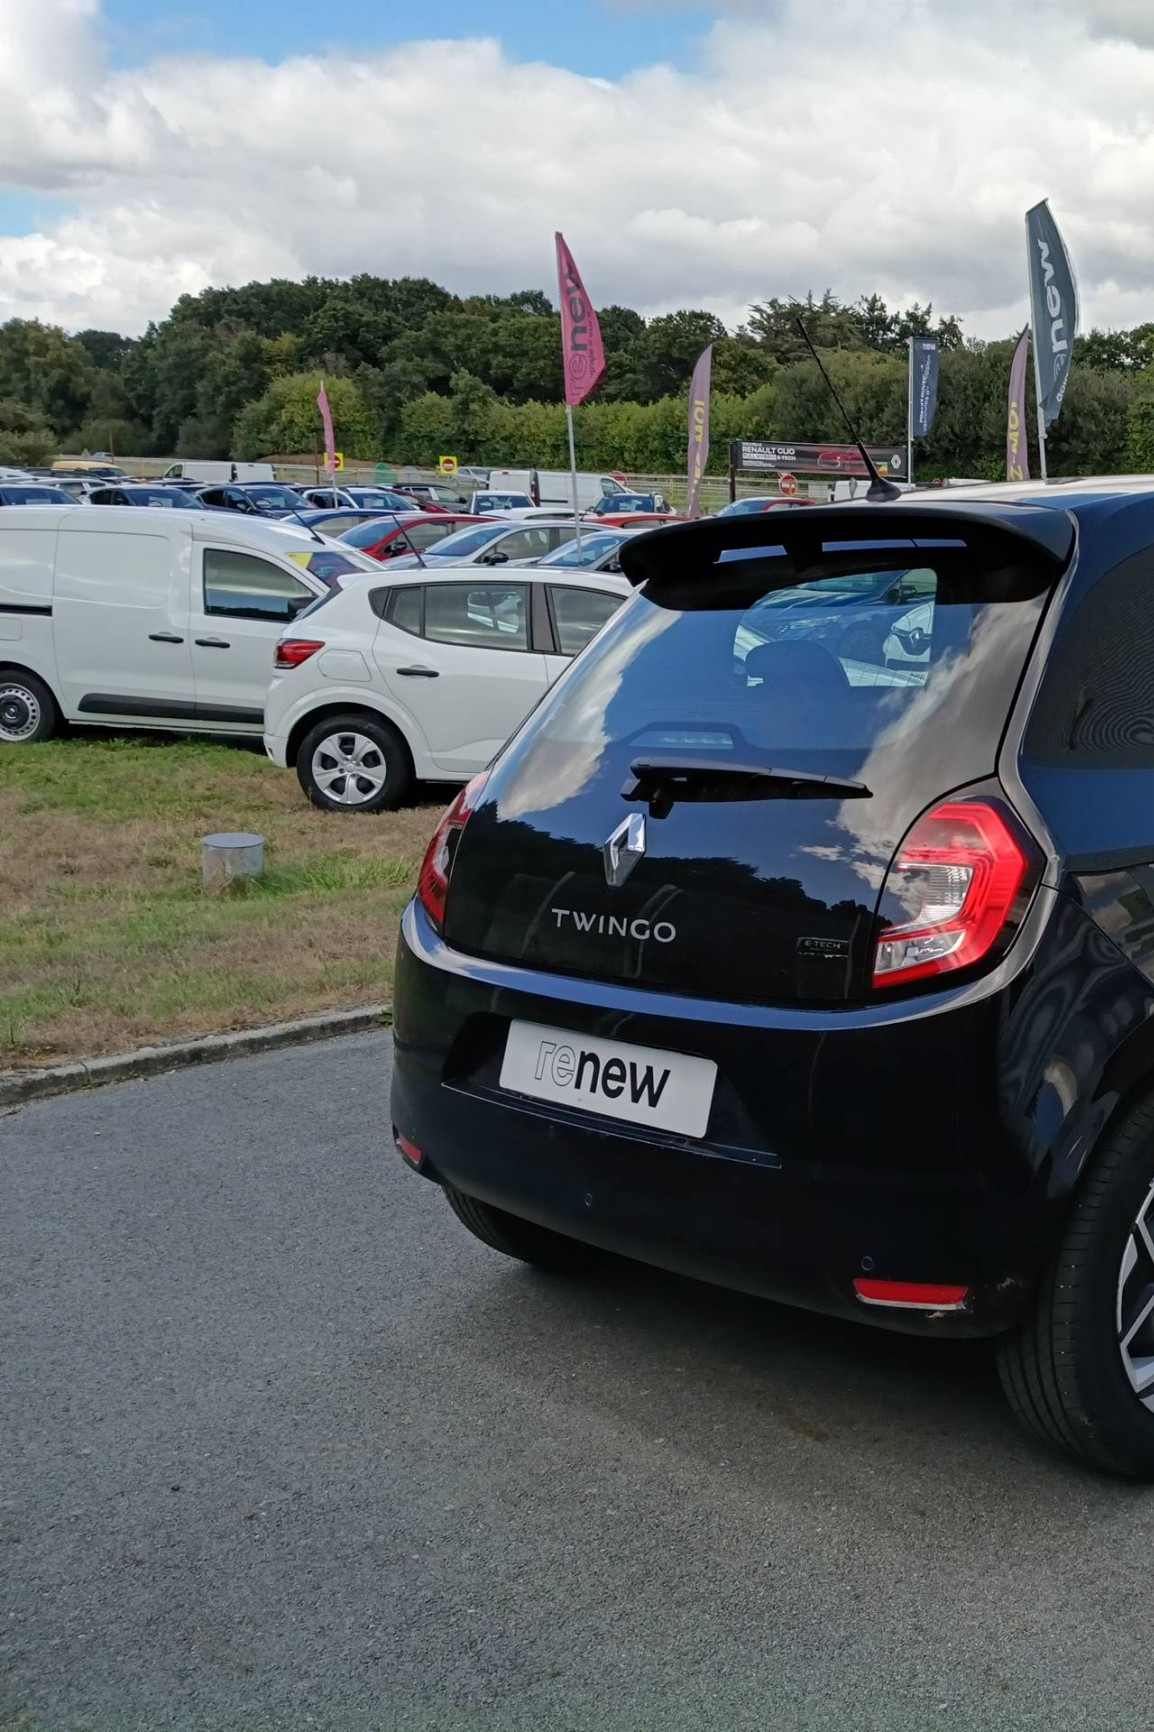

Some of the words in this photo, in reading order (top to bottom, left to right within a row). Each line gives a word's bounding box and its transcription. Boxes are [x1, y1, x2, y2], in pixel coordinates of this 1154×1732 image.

[742, 446, 776, 454] RENAULT
[551, 908, 676, 943] TWINGO
[534, 1041, 671, 1108] renew
